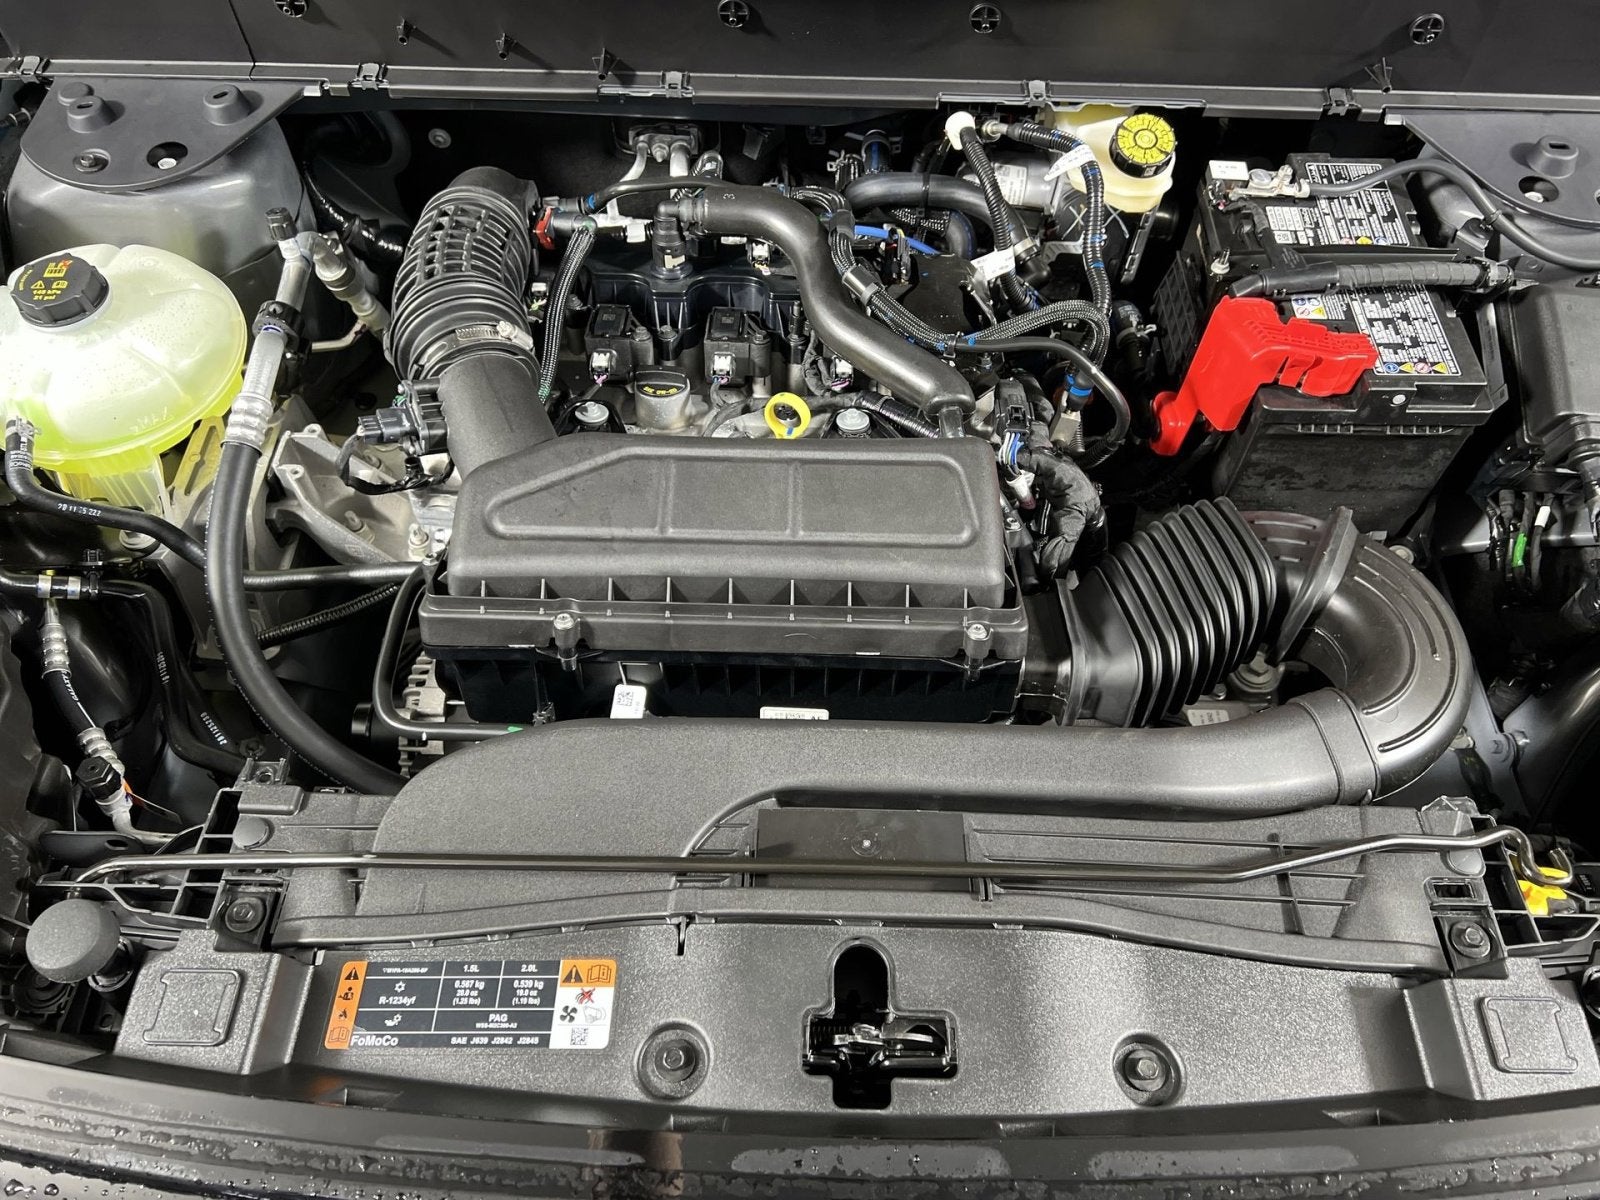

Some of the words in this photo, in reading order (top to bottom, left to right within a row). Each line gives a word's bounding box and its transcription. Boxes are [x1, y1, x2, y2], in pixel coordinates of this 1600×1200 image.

[463, 964, 479, 973] 1.5L
[521, 964, 538, 972] 2.0L
[474, 980, 485, 990] kg
[513, 980, 533, 988] 0.539
[534, 980, 544, 990] kg
[378, 996, 417, 1006] R-1234yf
[488, 1013, 508, 1022] PAG
[350, 1034, 399, 1047] FoMoCo
[450, 1037, 467, 1045] SAE
[470, 1037, 489, 1045] J639
[491, 1037, 513, 1045] J2842
[517, 1037, 539, 1045] J2845
